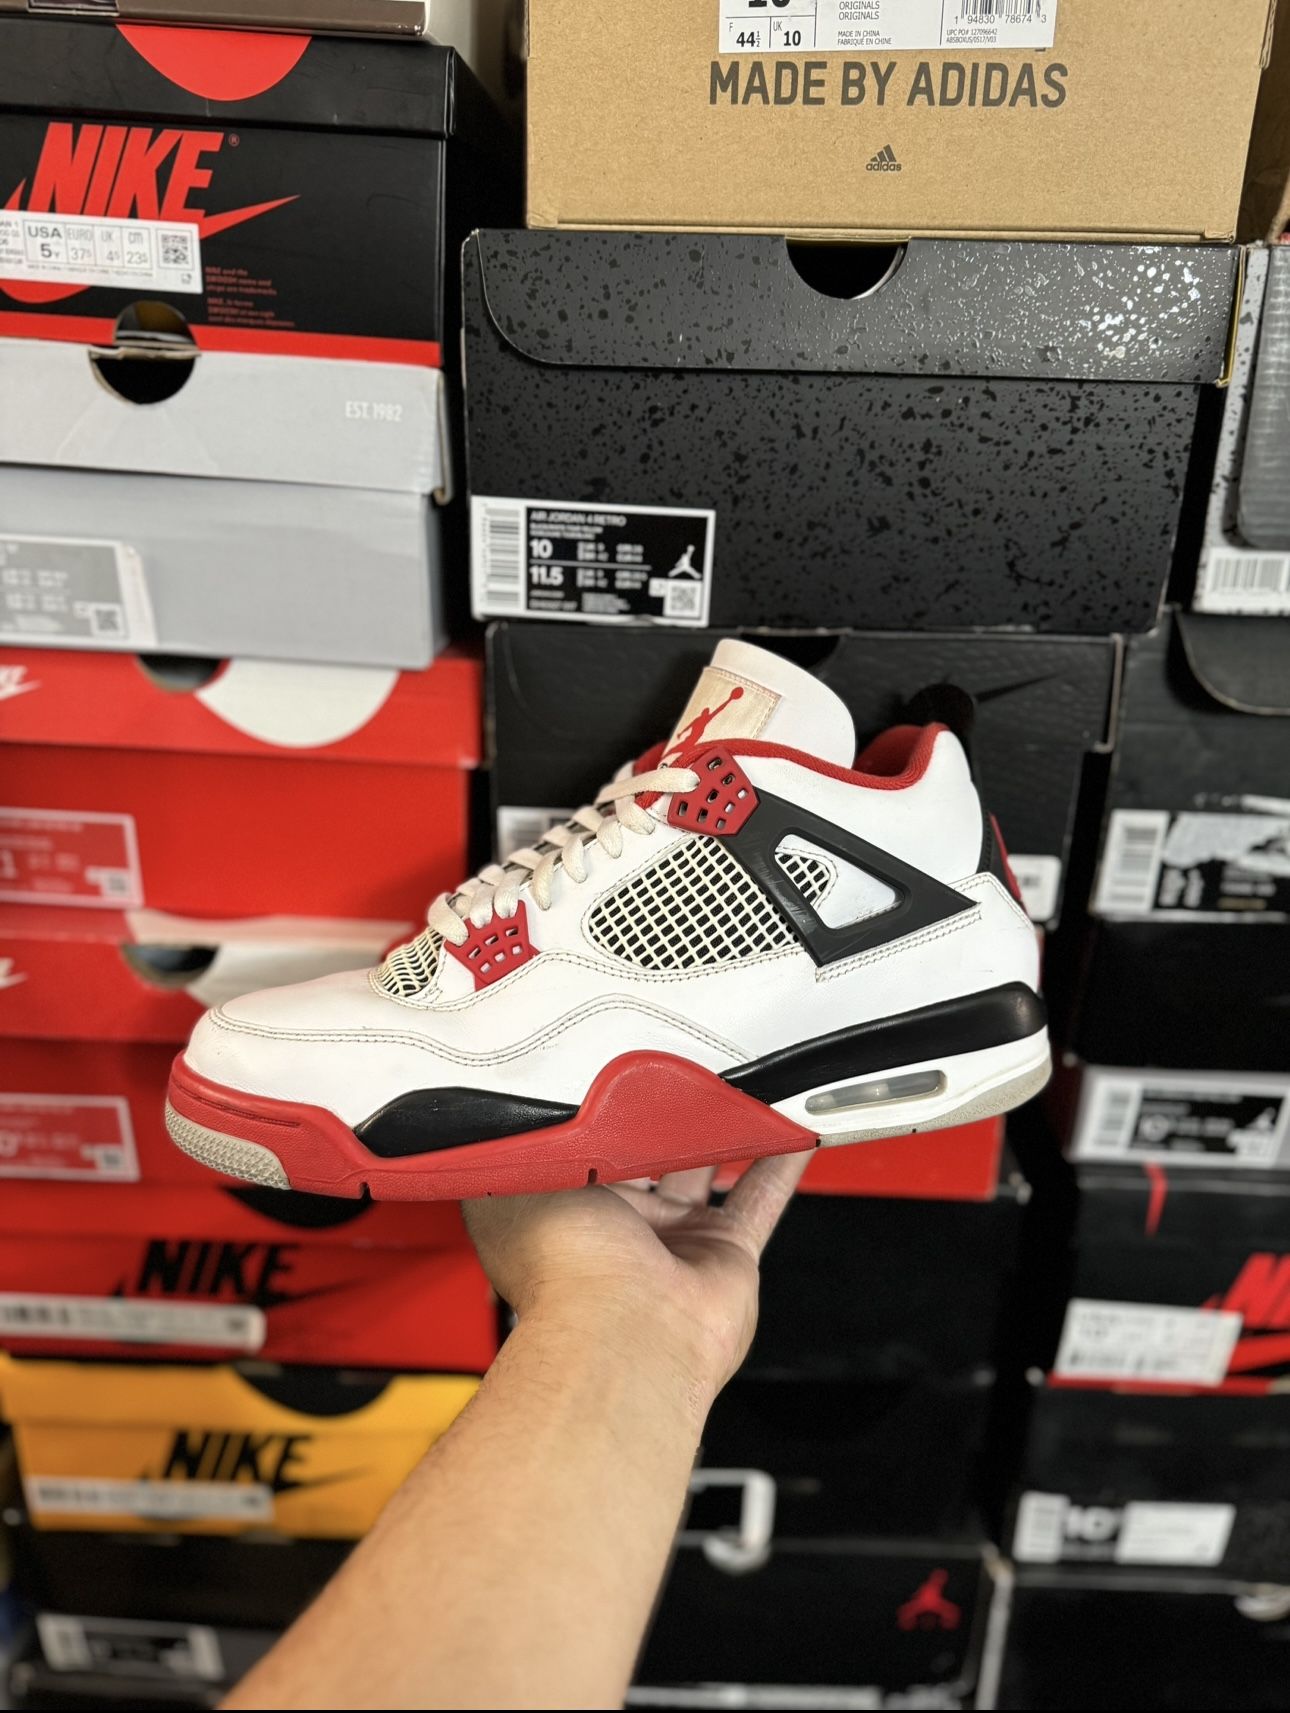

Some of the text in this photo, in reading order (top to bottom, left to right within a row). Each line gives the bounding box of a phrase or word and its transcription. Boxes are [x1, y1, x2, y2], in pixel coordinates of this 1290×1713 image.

[839, 1, 880, 10] ORIGINALS
[838, 11, 880, 20] ORIGINALS
[967, 15, 996, 24] 94830
[1005, 14, 1032, 24] 78674
[1041, 14, 1047, 24] 3
[729, 22, 734, 32] F
[772, 21, 782, 32] UK
[784, 30, 802, 46] 10
[709, 60, 1068, 108] MADE BY ADIDAS
[28, 121, 225, 220] NIKE
[866, 161, 902, 172] adidas
[28, 225, 63, 240] USA
[68, 228, 92, 242] EURO
[101, 230, 114, 242] UK
[373, 402, 403, 422] 1982
[548, 512, 586, 524] JORDAN
[529, 538, 553, 559] 10
[529, 565, 564, 586] 11.5
[138, 1239, 295, 1304] NIKE
[162, 1428, 312, 1491] NIKE
